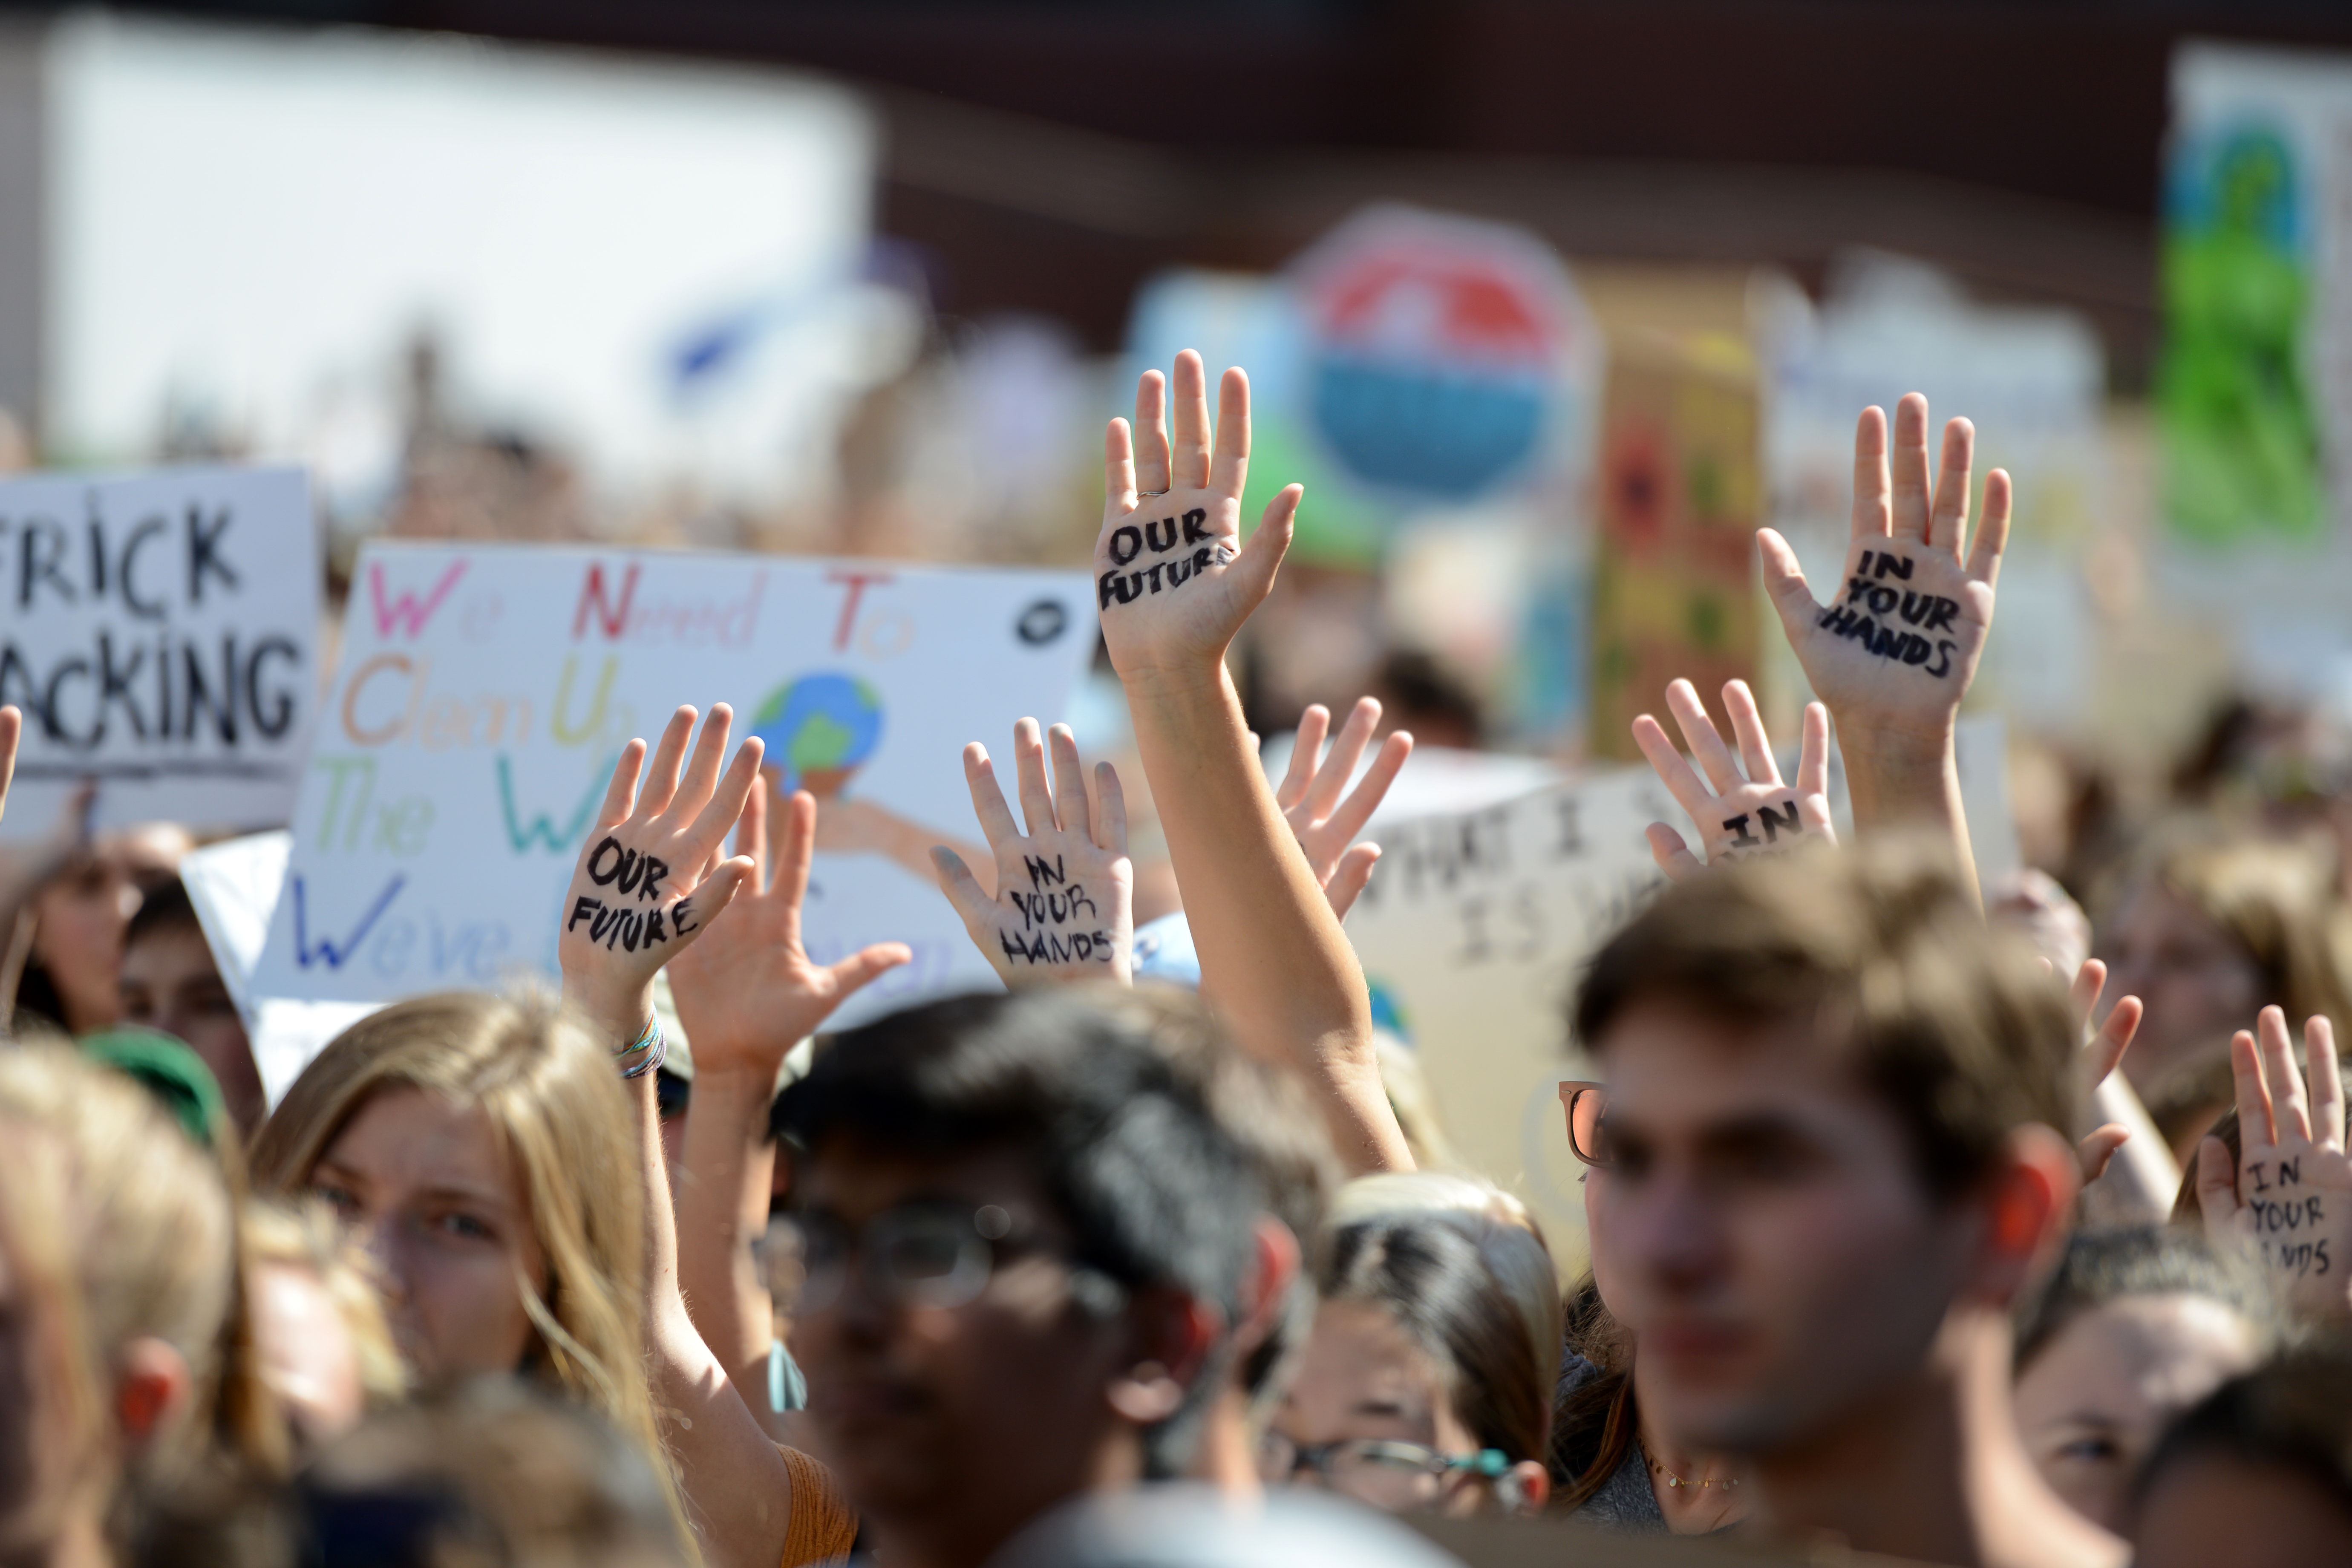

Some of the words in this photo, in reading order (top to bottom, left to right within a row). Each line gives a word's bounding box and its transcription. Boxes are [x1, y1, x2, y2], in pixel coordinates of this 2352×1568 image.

[0, 488, 241, 620] RICK
[1108, 507, 1213, 566] OUR
[1857, 550, 1914, 580] IN
[368, 555, 505, 644] We
[571, 557, 770, 650] Need
[822, 564, 917, 661] To
[1847, 577, 1960, 634] YOUR
[1819, 605, 1958, 678] HANDS
[341, 647, 538, 753] Clean
[312, 752, 437, 860] The
[1722, 800, 1803, 848] IN
[587, 836, 669, 902] OUR
[1023, 854, 1065, 893] IN
[568, 896, 699, 953] FUTURE
[1009, 883, 1097, 931] YOUR
[999, 927, 1114, 965] HANDS
[2246, 1155, 2300, 1193] IN
[2248, 1196, 2324, 1233] YOUR
